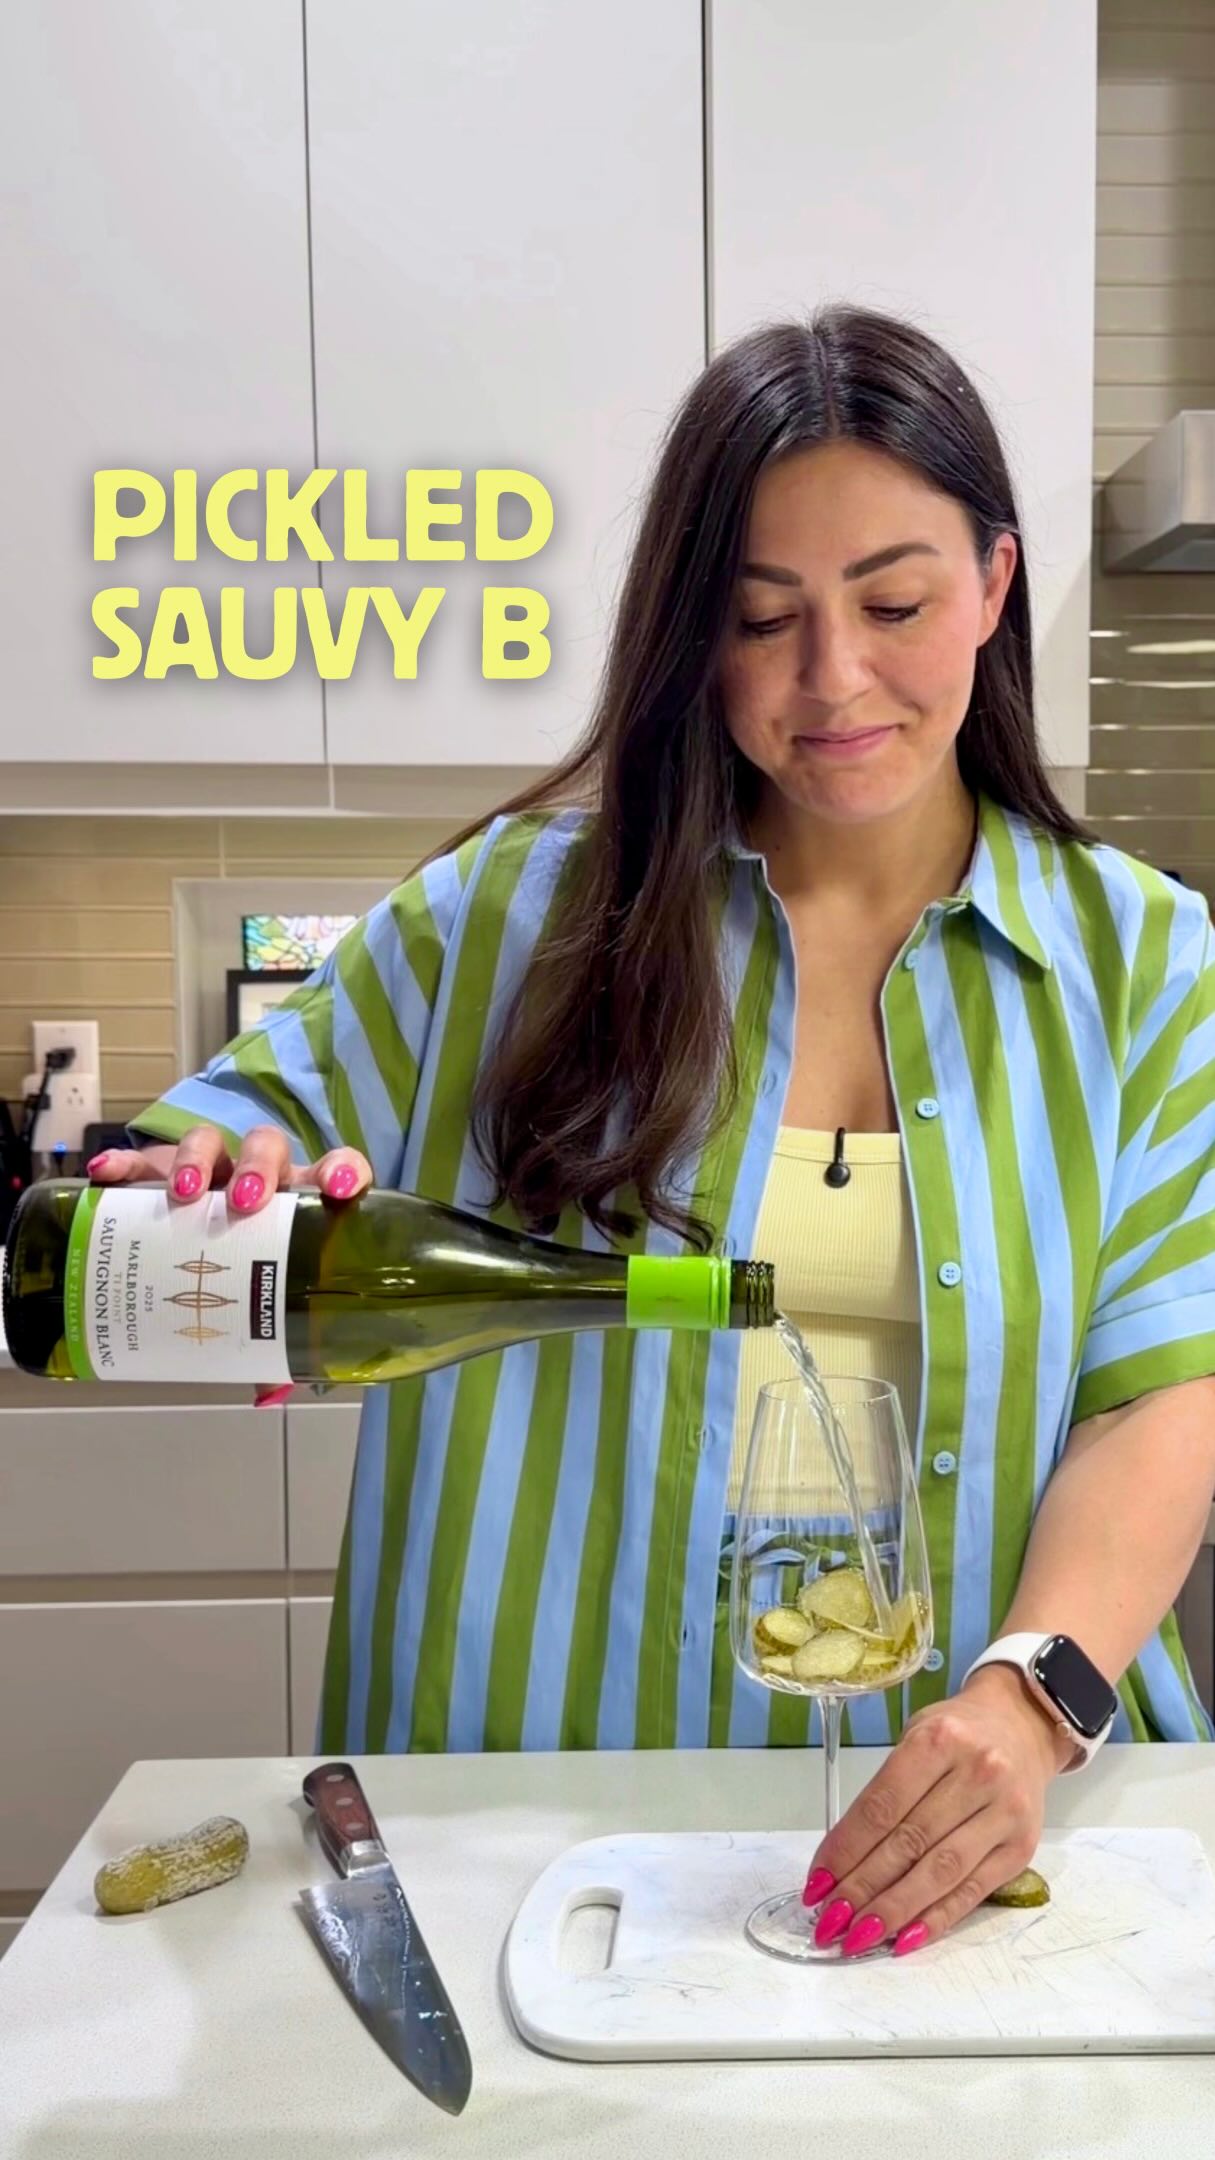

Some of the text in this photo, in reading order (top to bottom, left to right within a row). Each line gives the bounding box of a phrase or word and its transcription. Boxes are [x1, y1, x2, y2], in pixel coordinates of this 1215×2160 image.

[68, 1248, 81, 1342] NEW ZEALAND
[95, 1217, 117, 1367] SAUVIGNON BLANC
[113, 1289, 122, 1324] POINT
[126, 1240, 141, 1351] MARLBOROUGH
[145, 1285, 154, 1312] 2025
[260, 1265, 274, 1338] KIRKLAND
